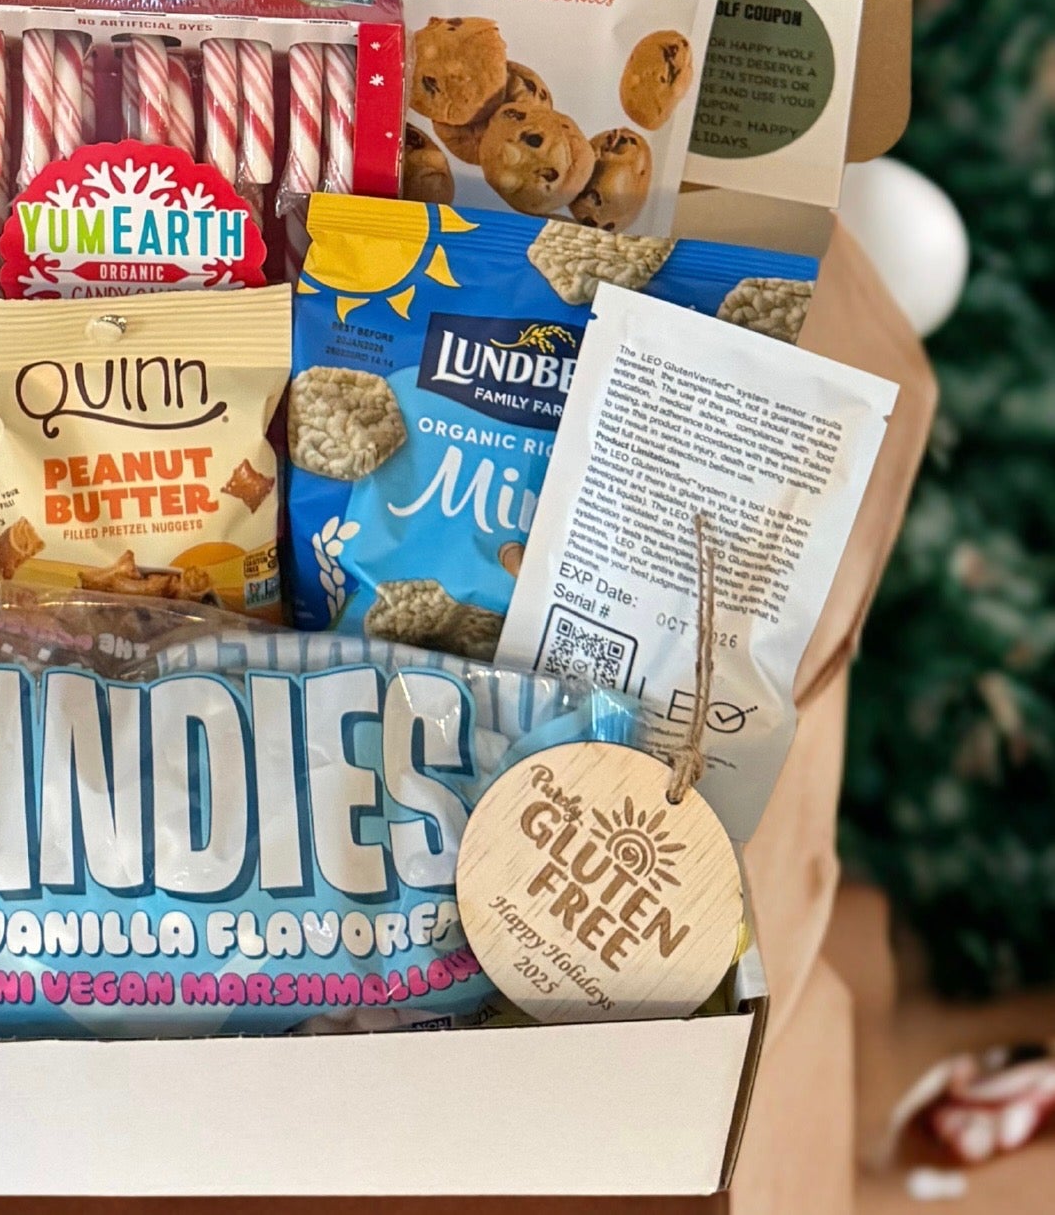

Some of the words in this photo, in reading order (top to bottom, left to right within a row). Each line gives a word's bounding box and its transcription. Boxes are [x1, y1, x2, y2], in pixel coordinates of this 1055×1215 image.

[78, 18, 96, 26] NO
[100, 19, 174, 31] ARTIFICIAL
[178, 23, 213, 32] DYES
[744, 3, 802, 27] COUPON
[100, 263, 165, 282] ORGANIC
[431, 329, 578, 394] LUNDBE
[474, 387, 529, 410] FAMILY
[533, 401, 563, 417] FAR
[620, 344, 636, 357] The
[640, 352, 662, 366] LEO
[736, 388, 769, 405] system
[774, 401, 806, 418] sensor
[811, 414, 842, 431] results
[418, 417, 515, 450] ORGANIC
[595, 430, 629, 450] Product
[630, 443, 680, 469] Limitations
[44, 447, 213, 490] PEANUT
[45, 484, 219, 525] BUTTER
[63, 528, 99, 540] FILLED
[102, 523, 148, 538] PRETZEL
[152, 519, 203, 534] NUGGETS
[553, 583, 596, 612] Serial
[598, 603, 612, 619] #
[559, 561, 593, 586] EXP
[596, 579, 640, 609] Date:
[655, 612, 689, 635] OCT
[530, 764, 583, 827] Purely
[520, 800, 691, 959] GLUTEN
[527, 862, 640, 973] FREE
[489, 895, 546, 949] Happy
[542, 944, 615, 1012] Holidays
[41, 968, 175, 1007] VEGAN
[513, 956, 560, 995] 2025
